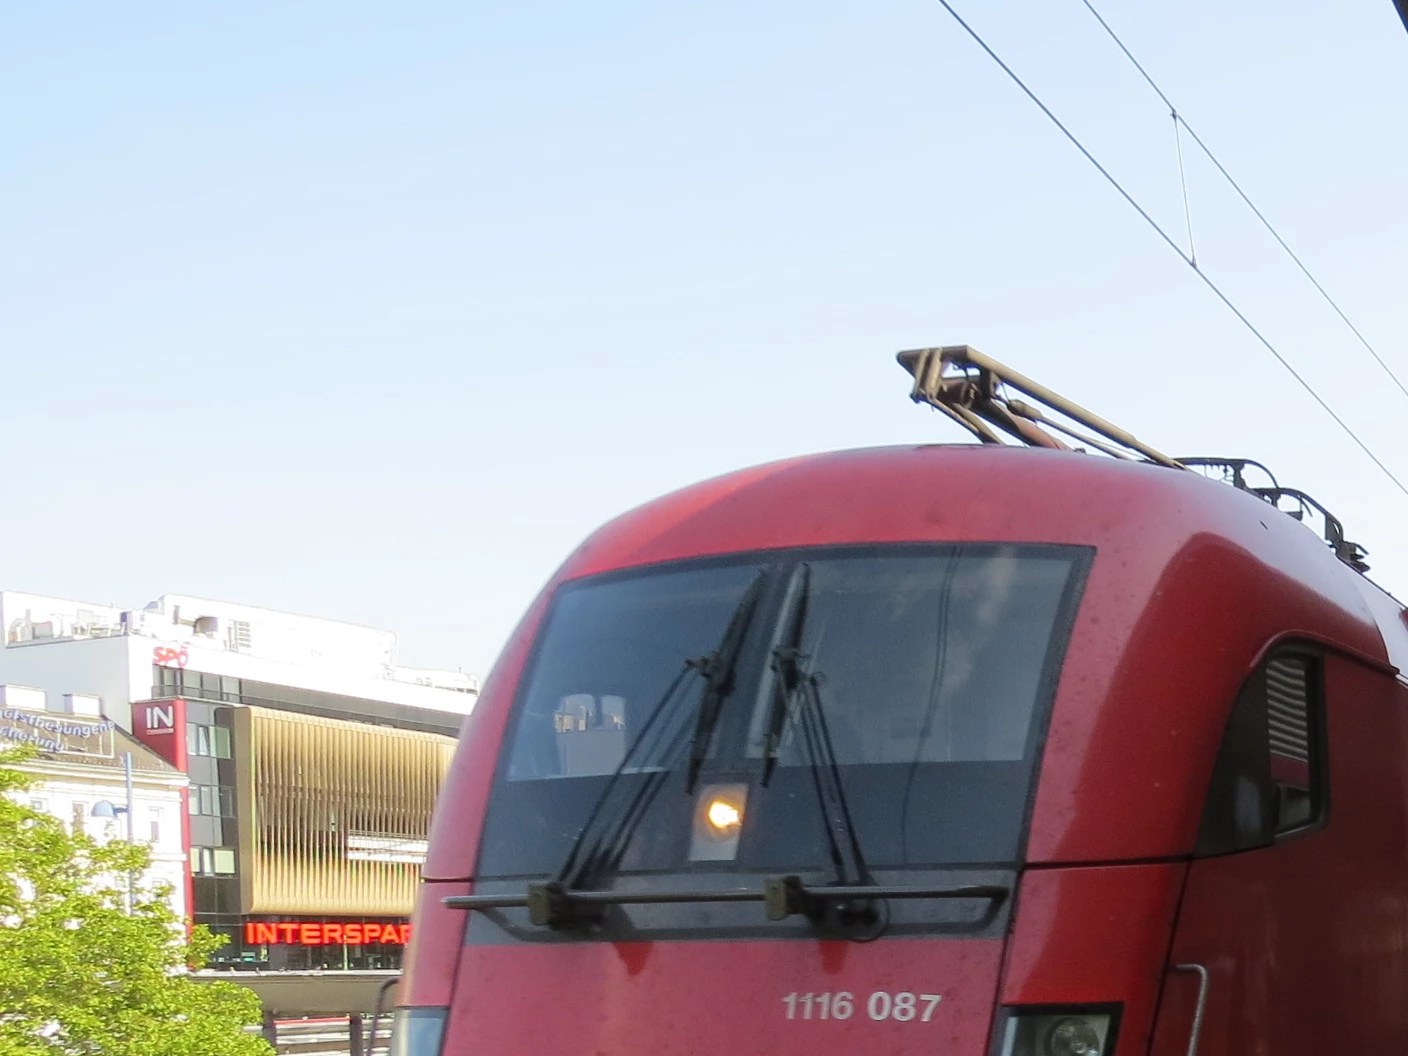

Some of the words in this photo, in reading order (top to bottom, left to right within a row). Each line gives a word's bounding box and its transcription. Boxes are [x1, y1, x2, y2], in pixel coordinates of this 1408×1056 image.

[153, 644, 188, 668] SPÖ
[146, 705, 174, 728] IN
[782, 991, 854, 1019] 1116
[867, 991, 942, 1022] 087
